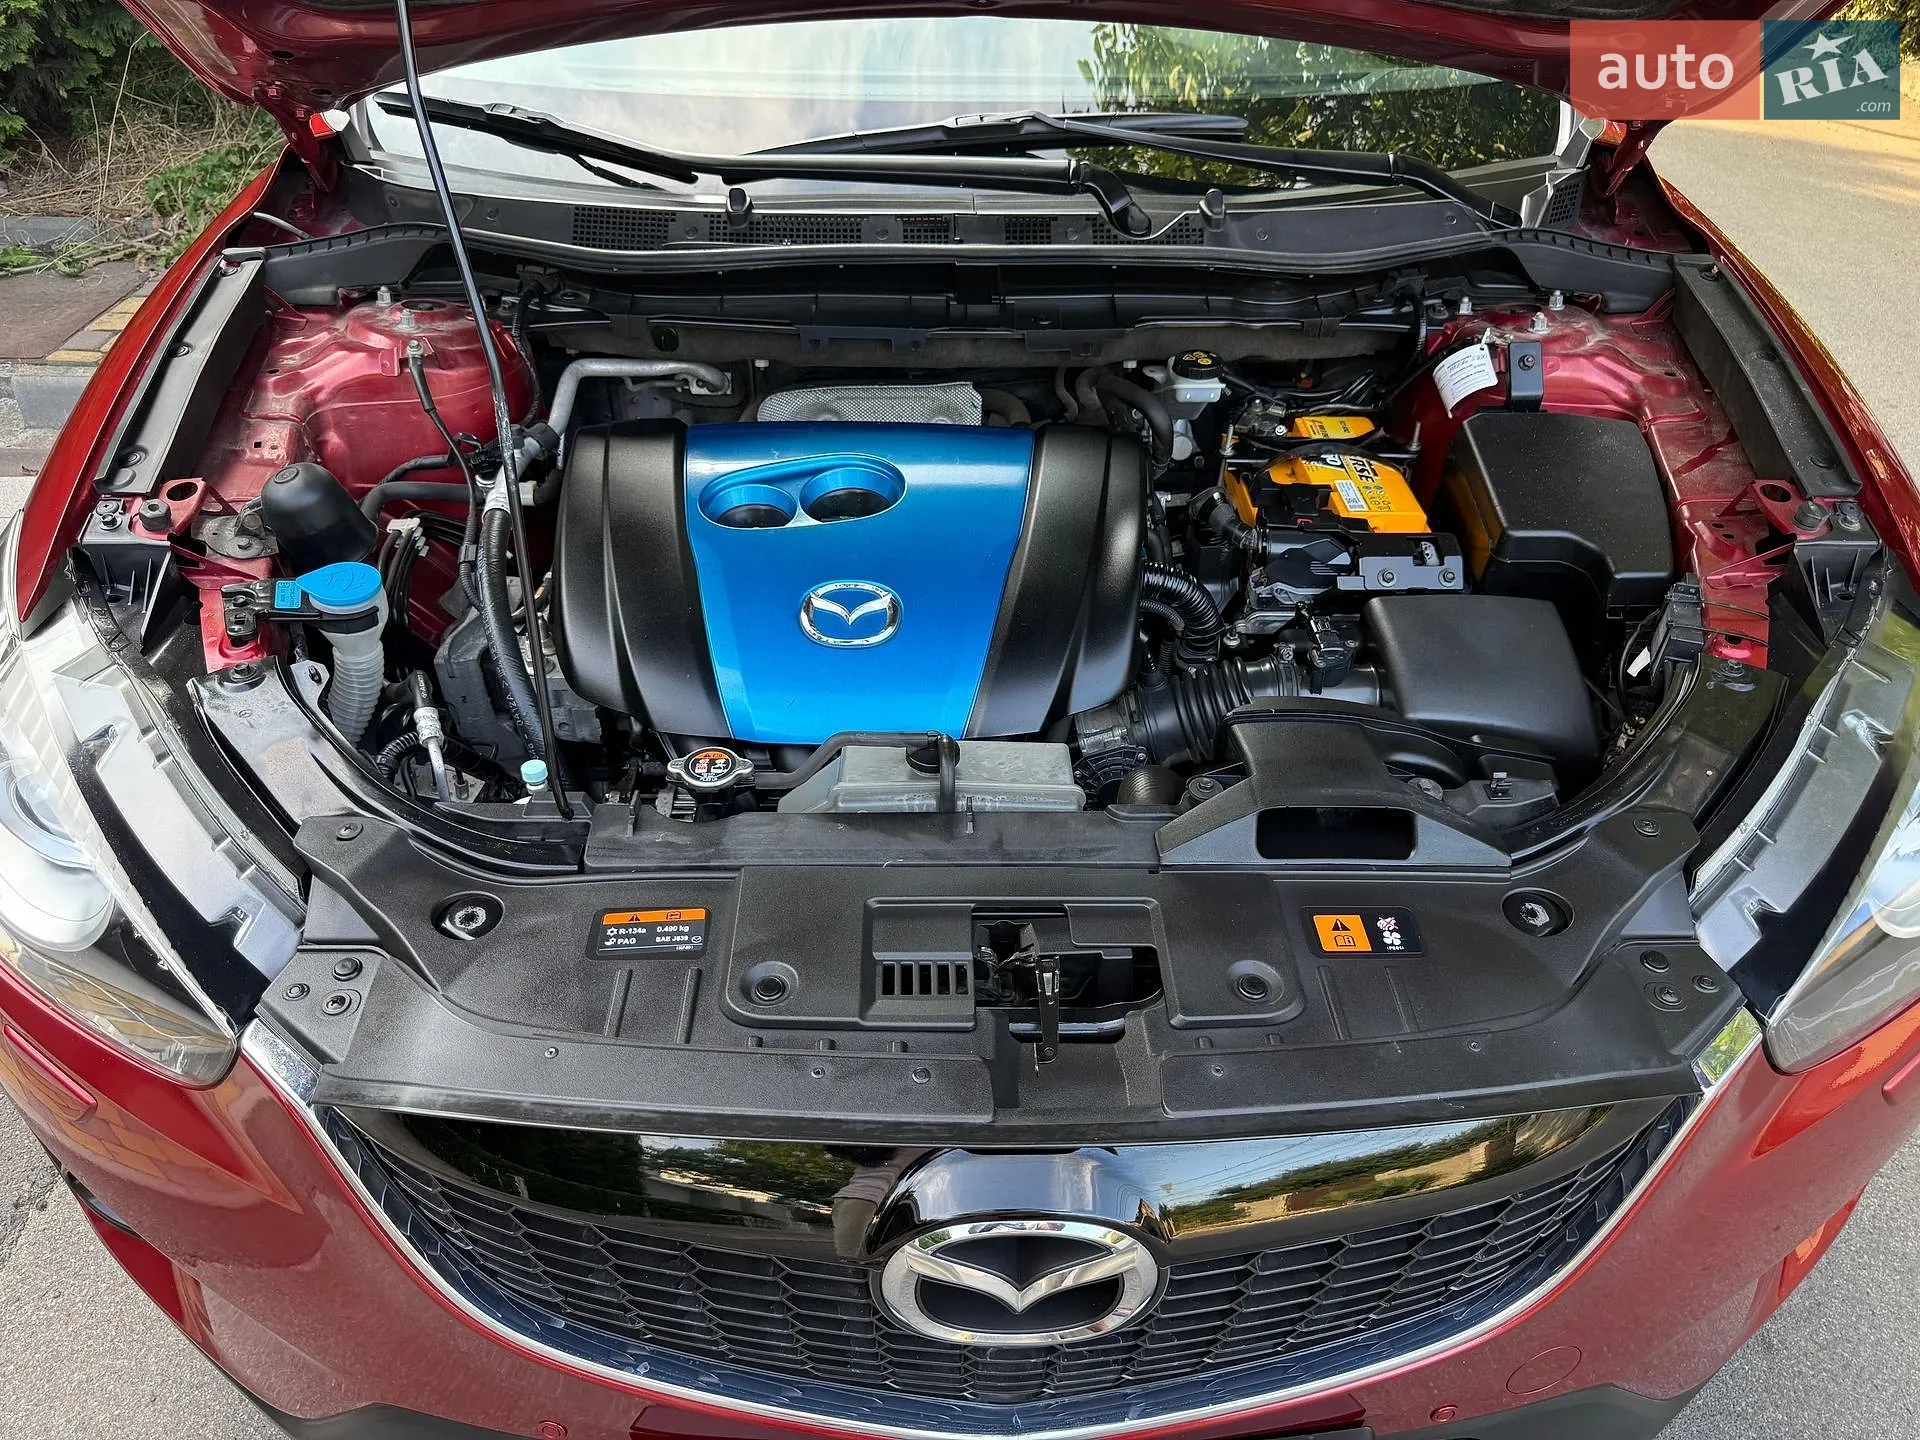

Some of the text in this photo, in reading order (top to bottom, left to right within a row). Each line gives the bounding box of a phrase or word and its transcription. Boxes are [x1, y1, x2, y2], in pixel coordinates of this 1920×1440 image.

[618, 927, 647, 935] R-134a
[656, 924, 690, 933] 0.490 kg
[617, 937, 637, 945] PAG
[655, 935, 671, 943] SAE
